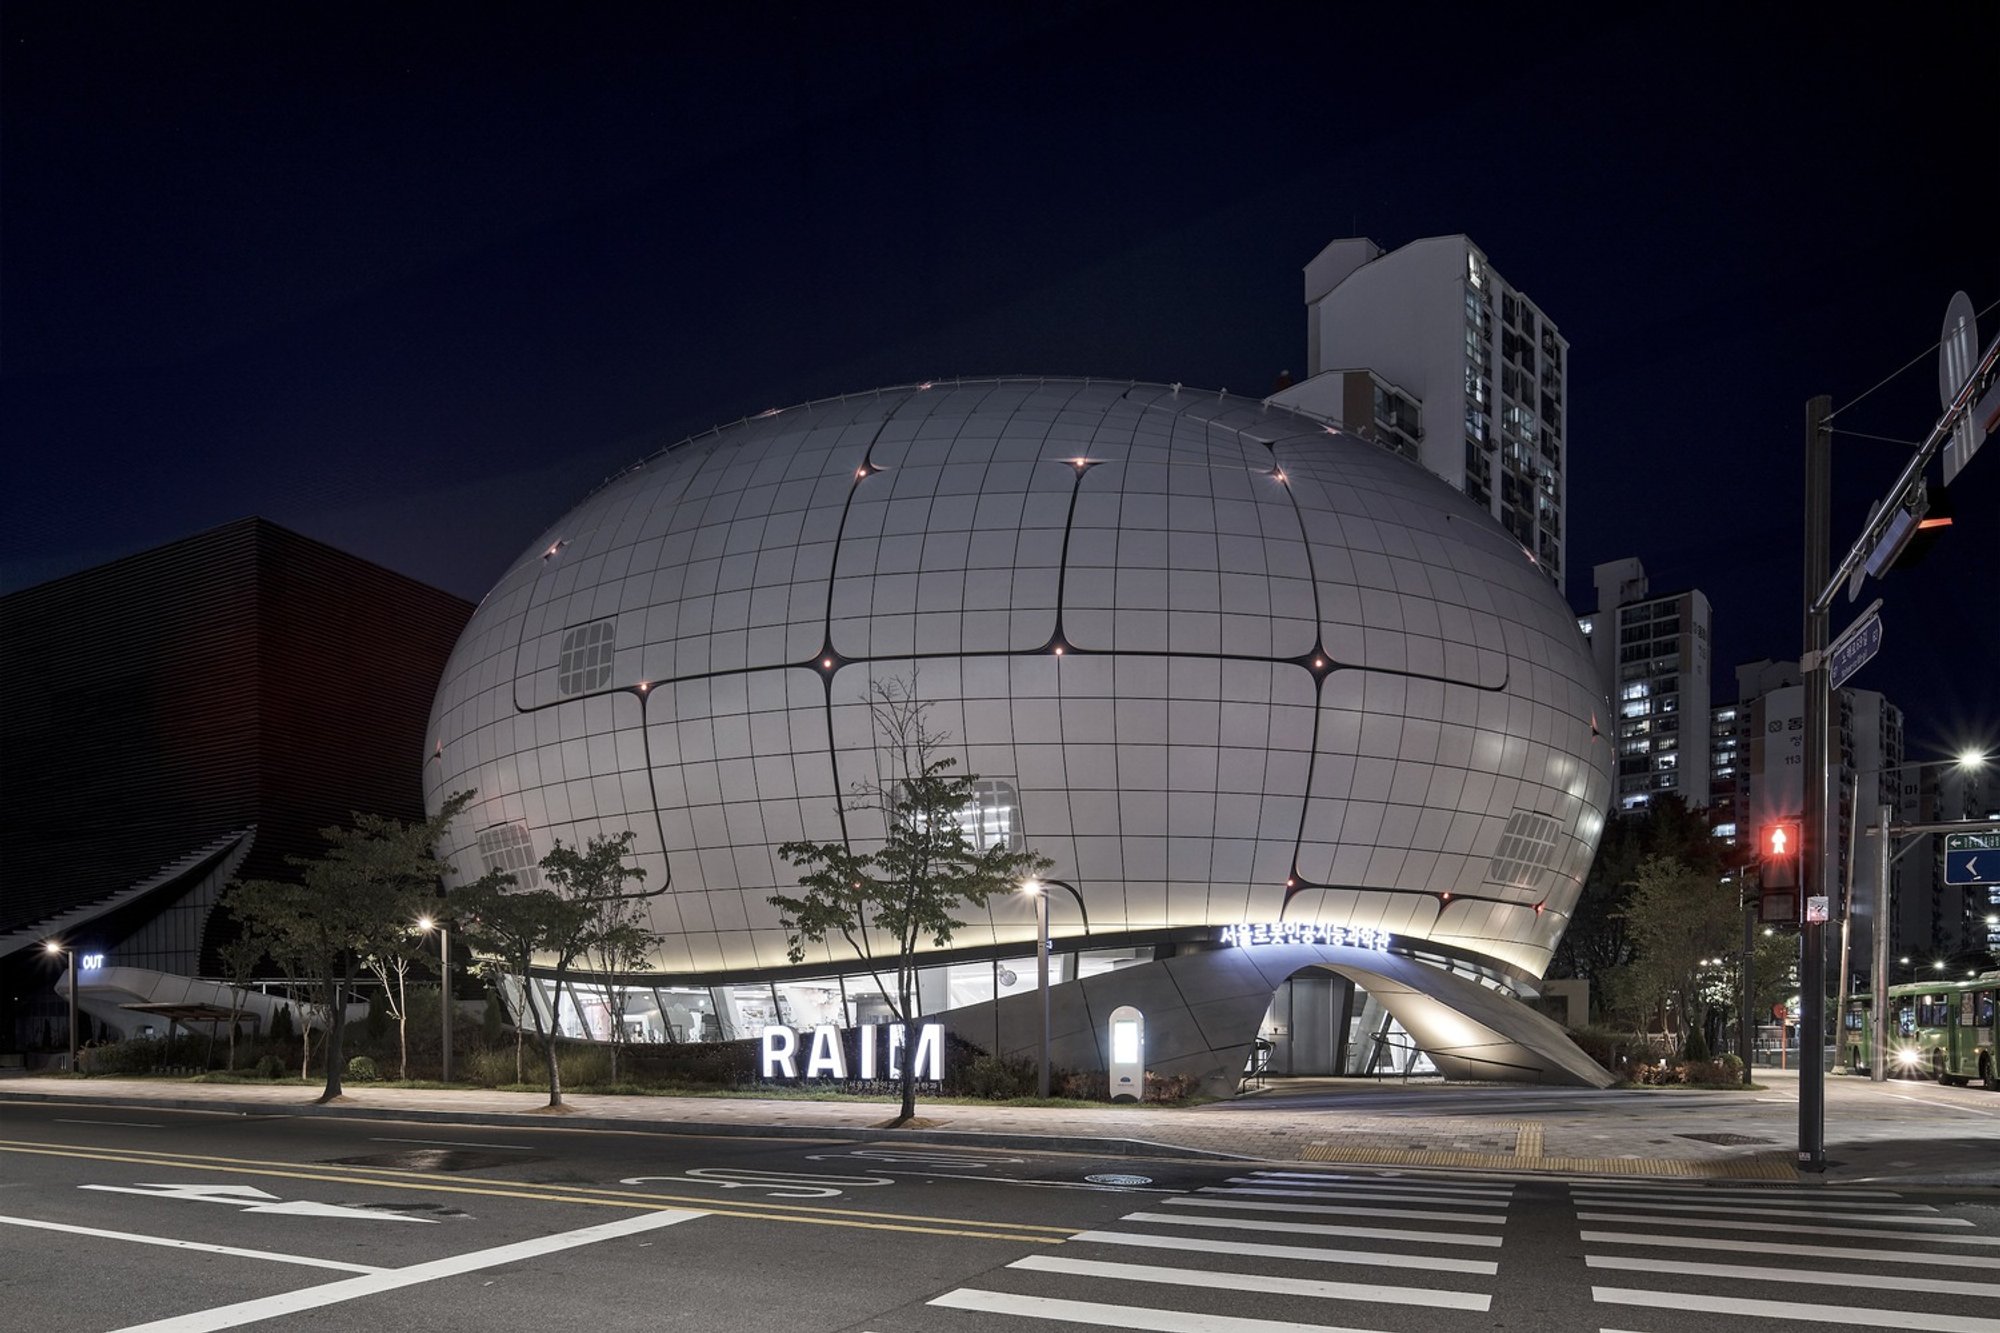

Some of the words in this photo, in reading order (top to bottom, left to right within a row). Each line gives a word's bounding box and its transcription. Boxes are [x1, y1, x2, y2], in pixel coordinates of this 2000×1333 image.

[1220, 922, 1392, 951] 서울로봇인공지능과학관
[82, 954, 104, 970] OUT
[762, 1024, 945, 1080] RAIM
